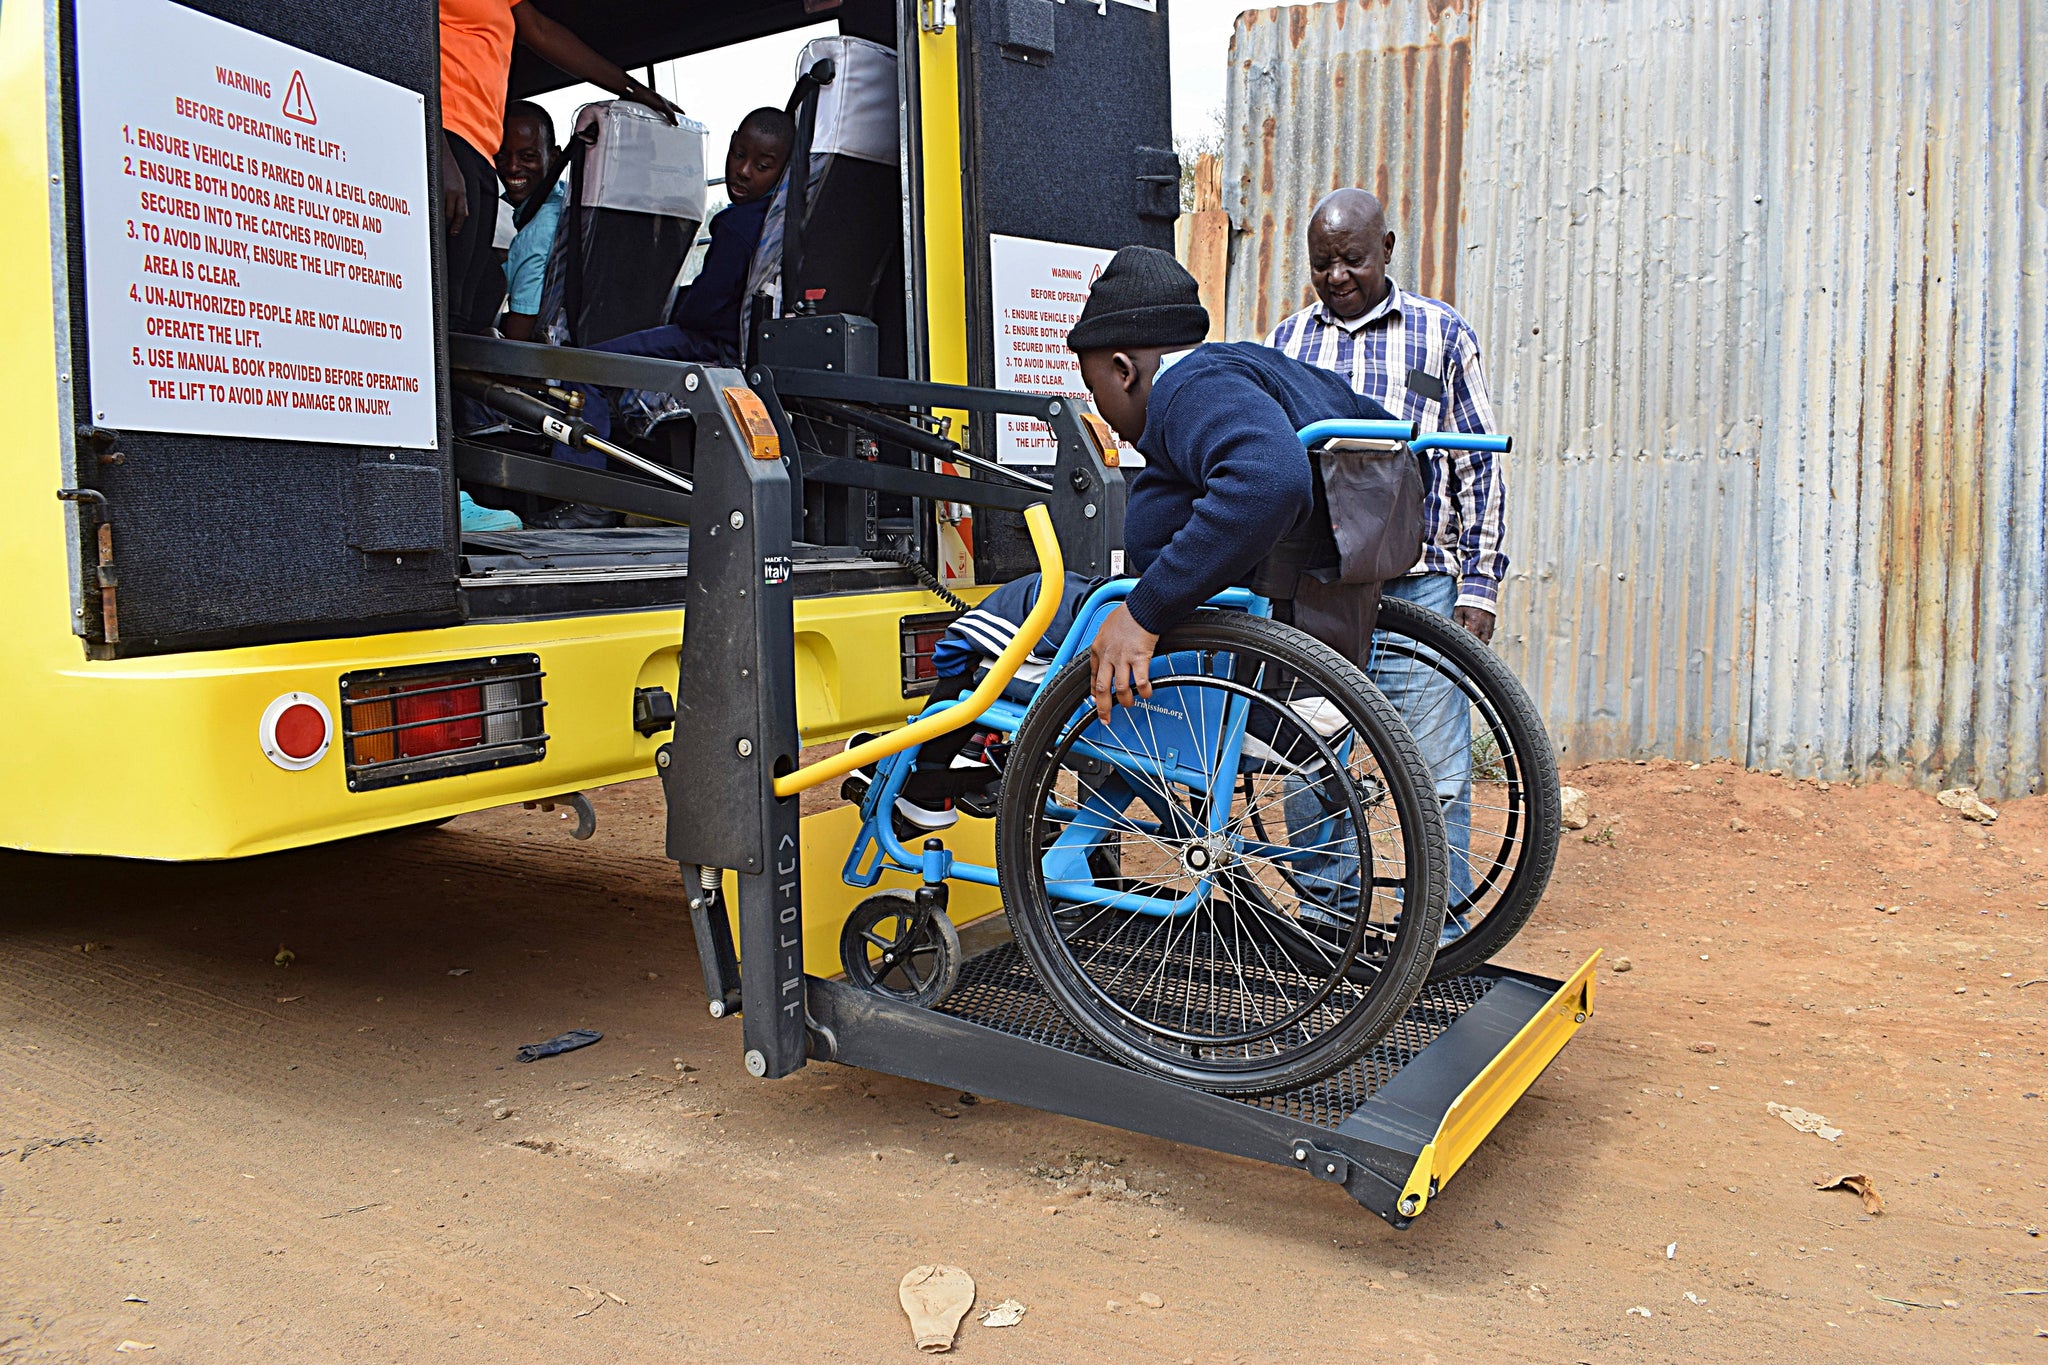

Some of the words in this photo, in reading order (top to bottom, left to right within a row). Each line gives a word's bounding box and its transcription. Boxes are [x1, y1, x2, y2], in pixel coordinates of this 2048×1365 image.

[216, 66, 270, 98] WARNING
[176, 97, 224, 127] BEFORE
[228, 113, 291, 146] OPERATING
[294, 132, 315, 153] THE
[123, 125, 134, 144] 1.
[138, 128, 190, 159] ENSURE
[193, 143, 244, 172] VEHICLE
[248, 158, 258, 176] IS
[262, 162, 304, 188] PARKED
[308, 175, 322, 193] ON
[326, 180, 332, 195] A
[336, 182, 366, 204] LEVEL
[369, 191, 410, 216] GROUND.
[124, 156, 136, 176] 2.
[140, 160, 191, 189] ENSURE
[195, 174, 227, 197] BOTH
[231, 183, 270, 207] DOORS
[274, 194, 295, 213] ARE
[298, 199, 330, 221] FULLY
[333, 208, 359, 228] OPEN
[362, 216, 381, 233] AND
[142, 192, 200, 220] SECURED
[204, 206, 232, 227] INTO
[235, 213, 258, 233] THE
[262, 219, 310, 244] CATCHES
[314, 230, 366, 259] PROVIDED,
[127, 220, 138, 239] 3.
[142, 223, 159, 243] TO
[164, 228, 201, 250] AVOID
[205, 235, 250, 263] INJURY,
[254, 245, 298, 269] ENSURE
[300, 255, 321, 274] THE
[324, 260, 345, 278] LIFT
[349, 265, 402, 289] OPERATING
[144, 255, 178, 277] AREA
[182, 261, 194, 279] IS
[198, 264, 240, 287] CLEAR.
[1052, 268, 1081, 280] WARNING
[1031, 289, 1056, 300] BEFORE
[1058, 292, 1088, 302] OPERATIN
[130, 284, 141, 302] 4.
[146, 286, 245, 316] UN-AUTHORIZED
[250, 302, 292, 324] PEOPLE
[295, 309, 316, 327] ARE
[319, 313, 339, 330] NOT
[342, 317, 387, 337] ALLOWED
[390, 324, 402, 340] TO
[1004, 309, 1010, 318] 1.
[1012, 309, 1038, 320] ENSURE
[1040, 312, 1066, 323] VEHICLE
[1069, 314, 1074, 323] IS
[147, 317, 204, 341] OPERATE
[208, 325, 232, 344] THE
[235, 329, 261, 348] LIFT.
[1005, 325, 1010, 334] 2.
[1013, 325, 1038, 336] ENSURE
[1041, 328, 1058, 338] BOTH
[1013, 342, 1043, 352] SECURED
[1045, 344, 1060, 354] INTO
[1062, 345, 1074, 354] TH
[133, 347, 144, 365] 5.
[148, 348, 174, 368] USE
[178, 352, 229, 373] MANUAL
[233, 358, 265, 377] BOOK
[269, 362, 321, 382] PROVIDED
[325, 368, 363, 387] BEFORE
[366, 373, 418, 392] OPERATING
[1006, 357, 1012, 366] 3.
[1014, 358, 1022, 367] TO
[1024, 358, 1043, 368] AVOID
[1046, 360, 1069, 371] INJURY,
[1015, 374, 1032, 383] AREA
[1034, 375, 1040, 384] IS
[1042, 375, 1064, 385] CLEAR.
[149, 380, 175, 399] THE
[179, 382, 205, 401] LIFT
[209, 385, 225, 402] TO
[229, 386, 263, 405] AVOID
[266, 390, 288, 407] ANY
[292, 392, 335, 411] DAMAGE
[338, 396, 352, 412] OR
[355, 398, 391, 415] INJURY.
[1008, 422, 1014, 431] 5.
[1016, 422, 1029, 432] USE
[1016, 438, 1029, 448] THE
[1031, 438, 1044, 448] LIFT
[1046, 439, 1055, 448] TO
[764, 556, 783, 564] MADE
[764, 564, 790, 581] Italy
